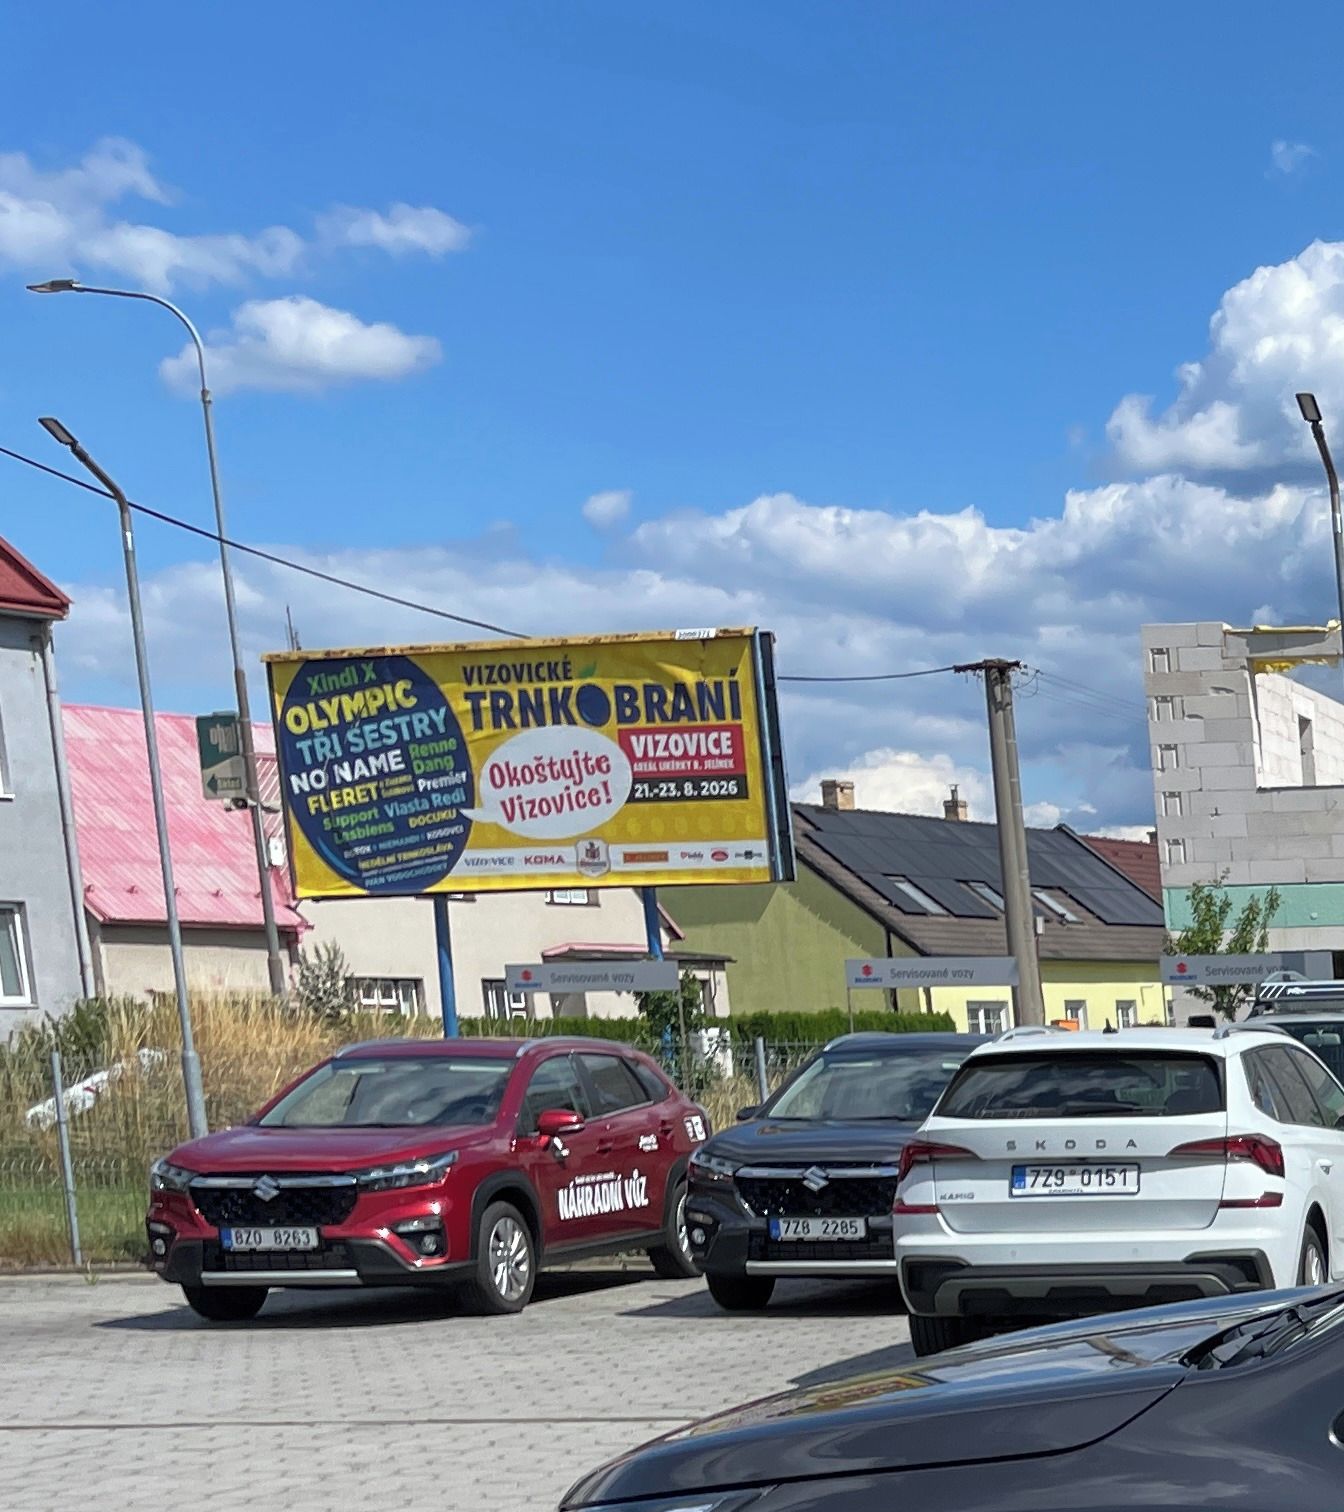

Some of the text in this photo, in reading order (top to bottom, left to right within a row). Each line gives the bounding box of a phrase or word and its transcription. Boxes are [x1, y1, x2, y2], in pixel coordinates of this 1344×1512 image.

[306, 661, 377, 696] Xindl X
[462, 655, 572, 686] VIZOVICKÉ
[285, 679, 418, 735] OLYMPIC
[296, 706, 447, 765] TŘI SESTRY
[630, 731, 733, 758] VIZOVICE
[289, 749, 406, 795] NO NAME
[412, 755, 455, 776] Dang
[489, 750, 612, 790] Okoštujte
[307, 782, 379, 816] FLERET
[384, 788, 466, 818] Vlasta Redl
[500, 780, 613, 824] Vizovice!
[700, 780, 738, 796] 2026
[524, 855, 565, 865] KOMA
[890, 968, 974, 979] Servisované vozy
[1205, 965, 1263, 977] Servisované
[1029, 1167, 1128, 1188] 7Z9 0151
[558, 1168, 648, 1220] NÁHRADNÍ VŮZ
[783, 1220, 858, 1235] 7Z8 2285
